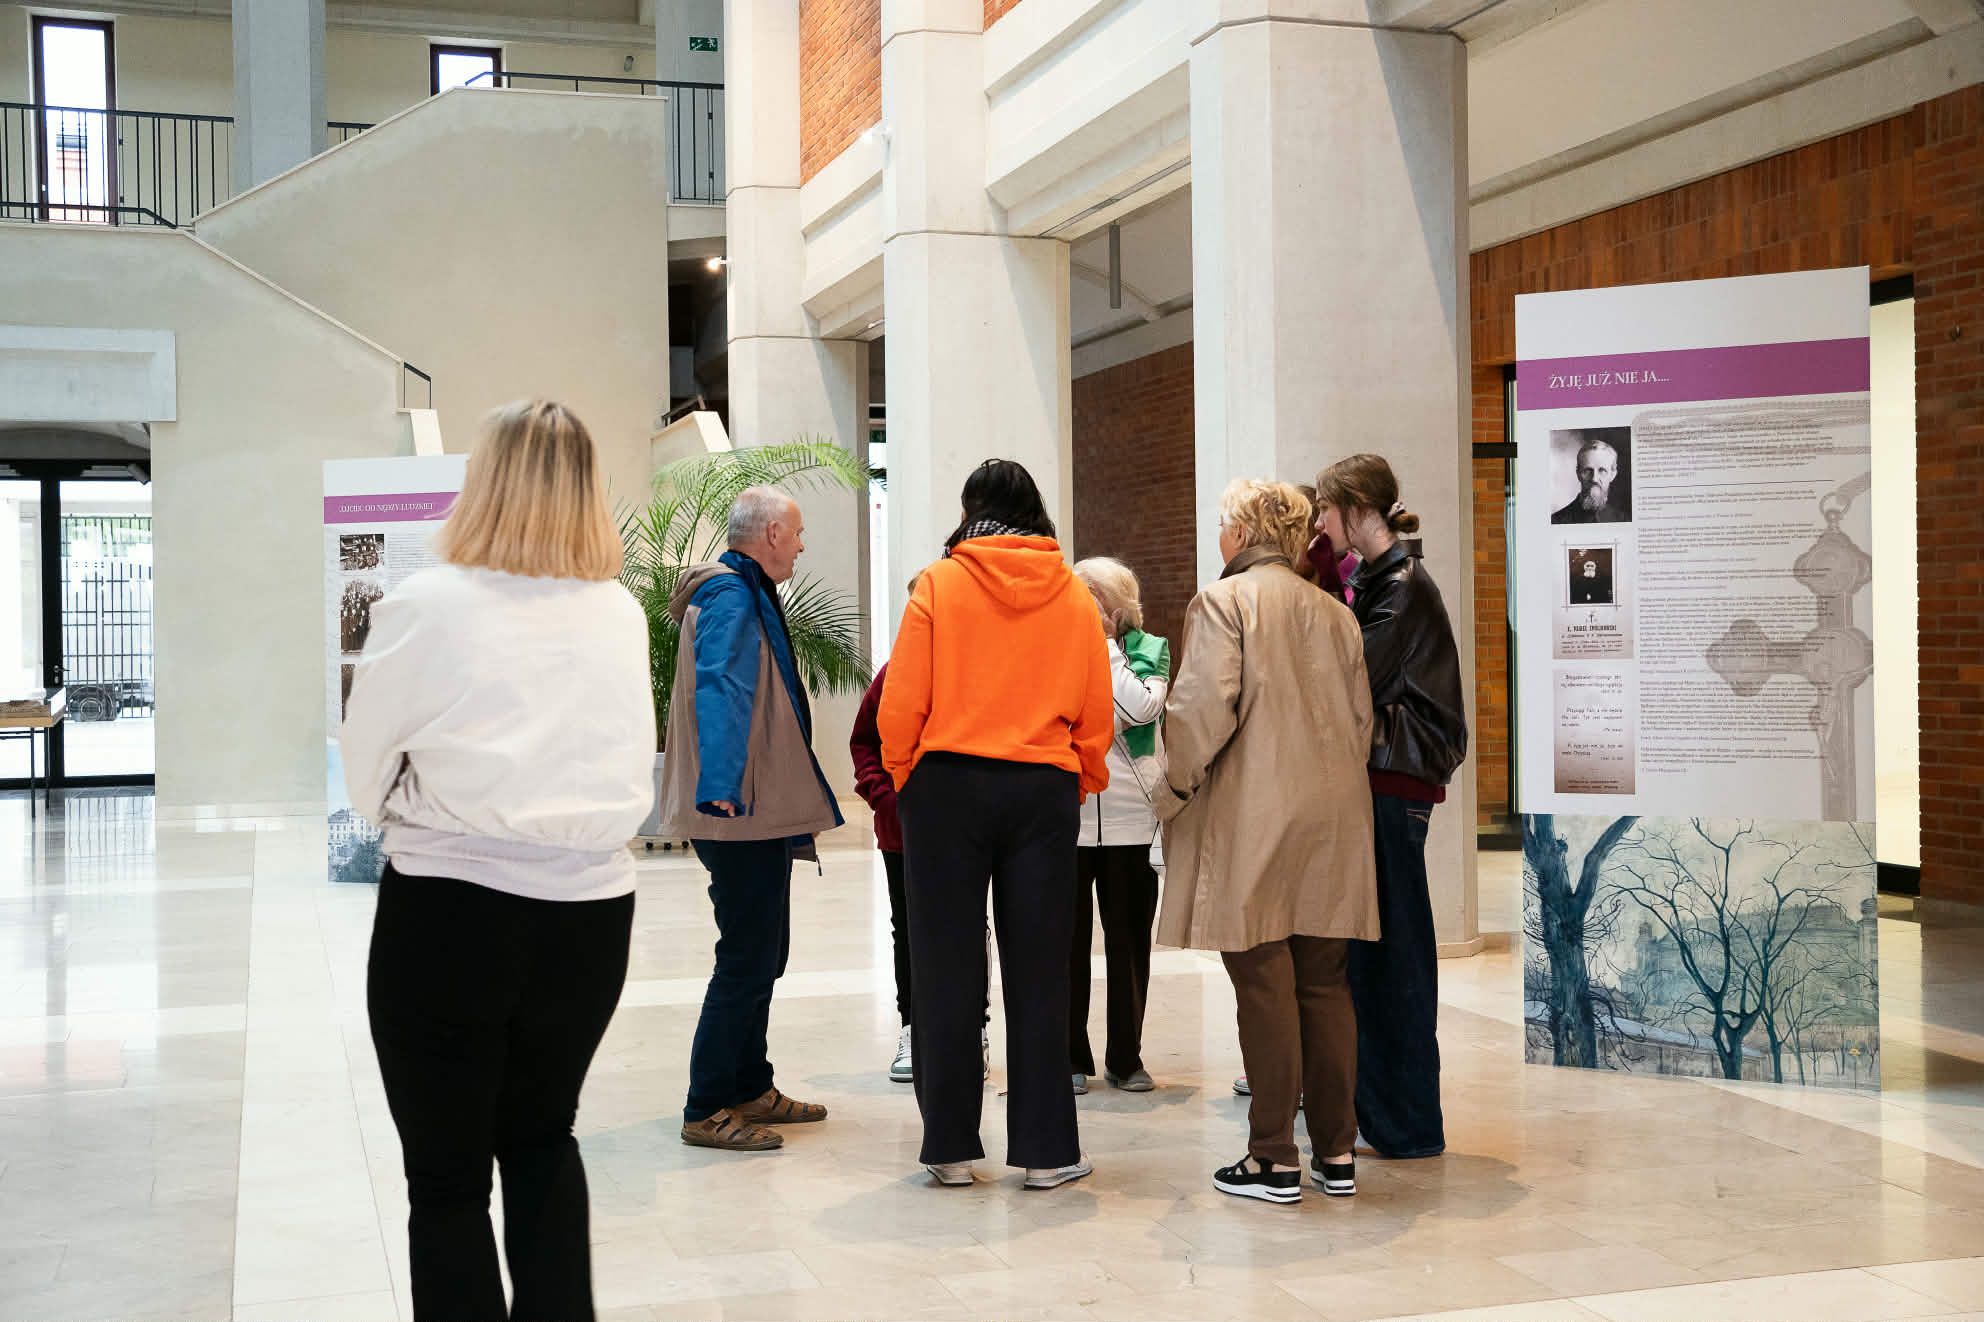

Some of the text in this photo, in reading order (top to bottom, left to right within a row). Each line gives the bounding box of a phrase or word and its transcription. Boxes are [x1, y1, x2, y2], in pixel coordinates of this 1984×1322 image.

[1549, 374, 1582, 390] ŻYJĘ
[1585, 371, 1612, 386] JUŻ
[1615, 370, 1638, 384] NIE
